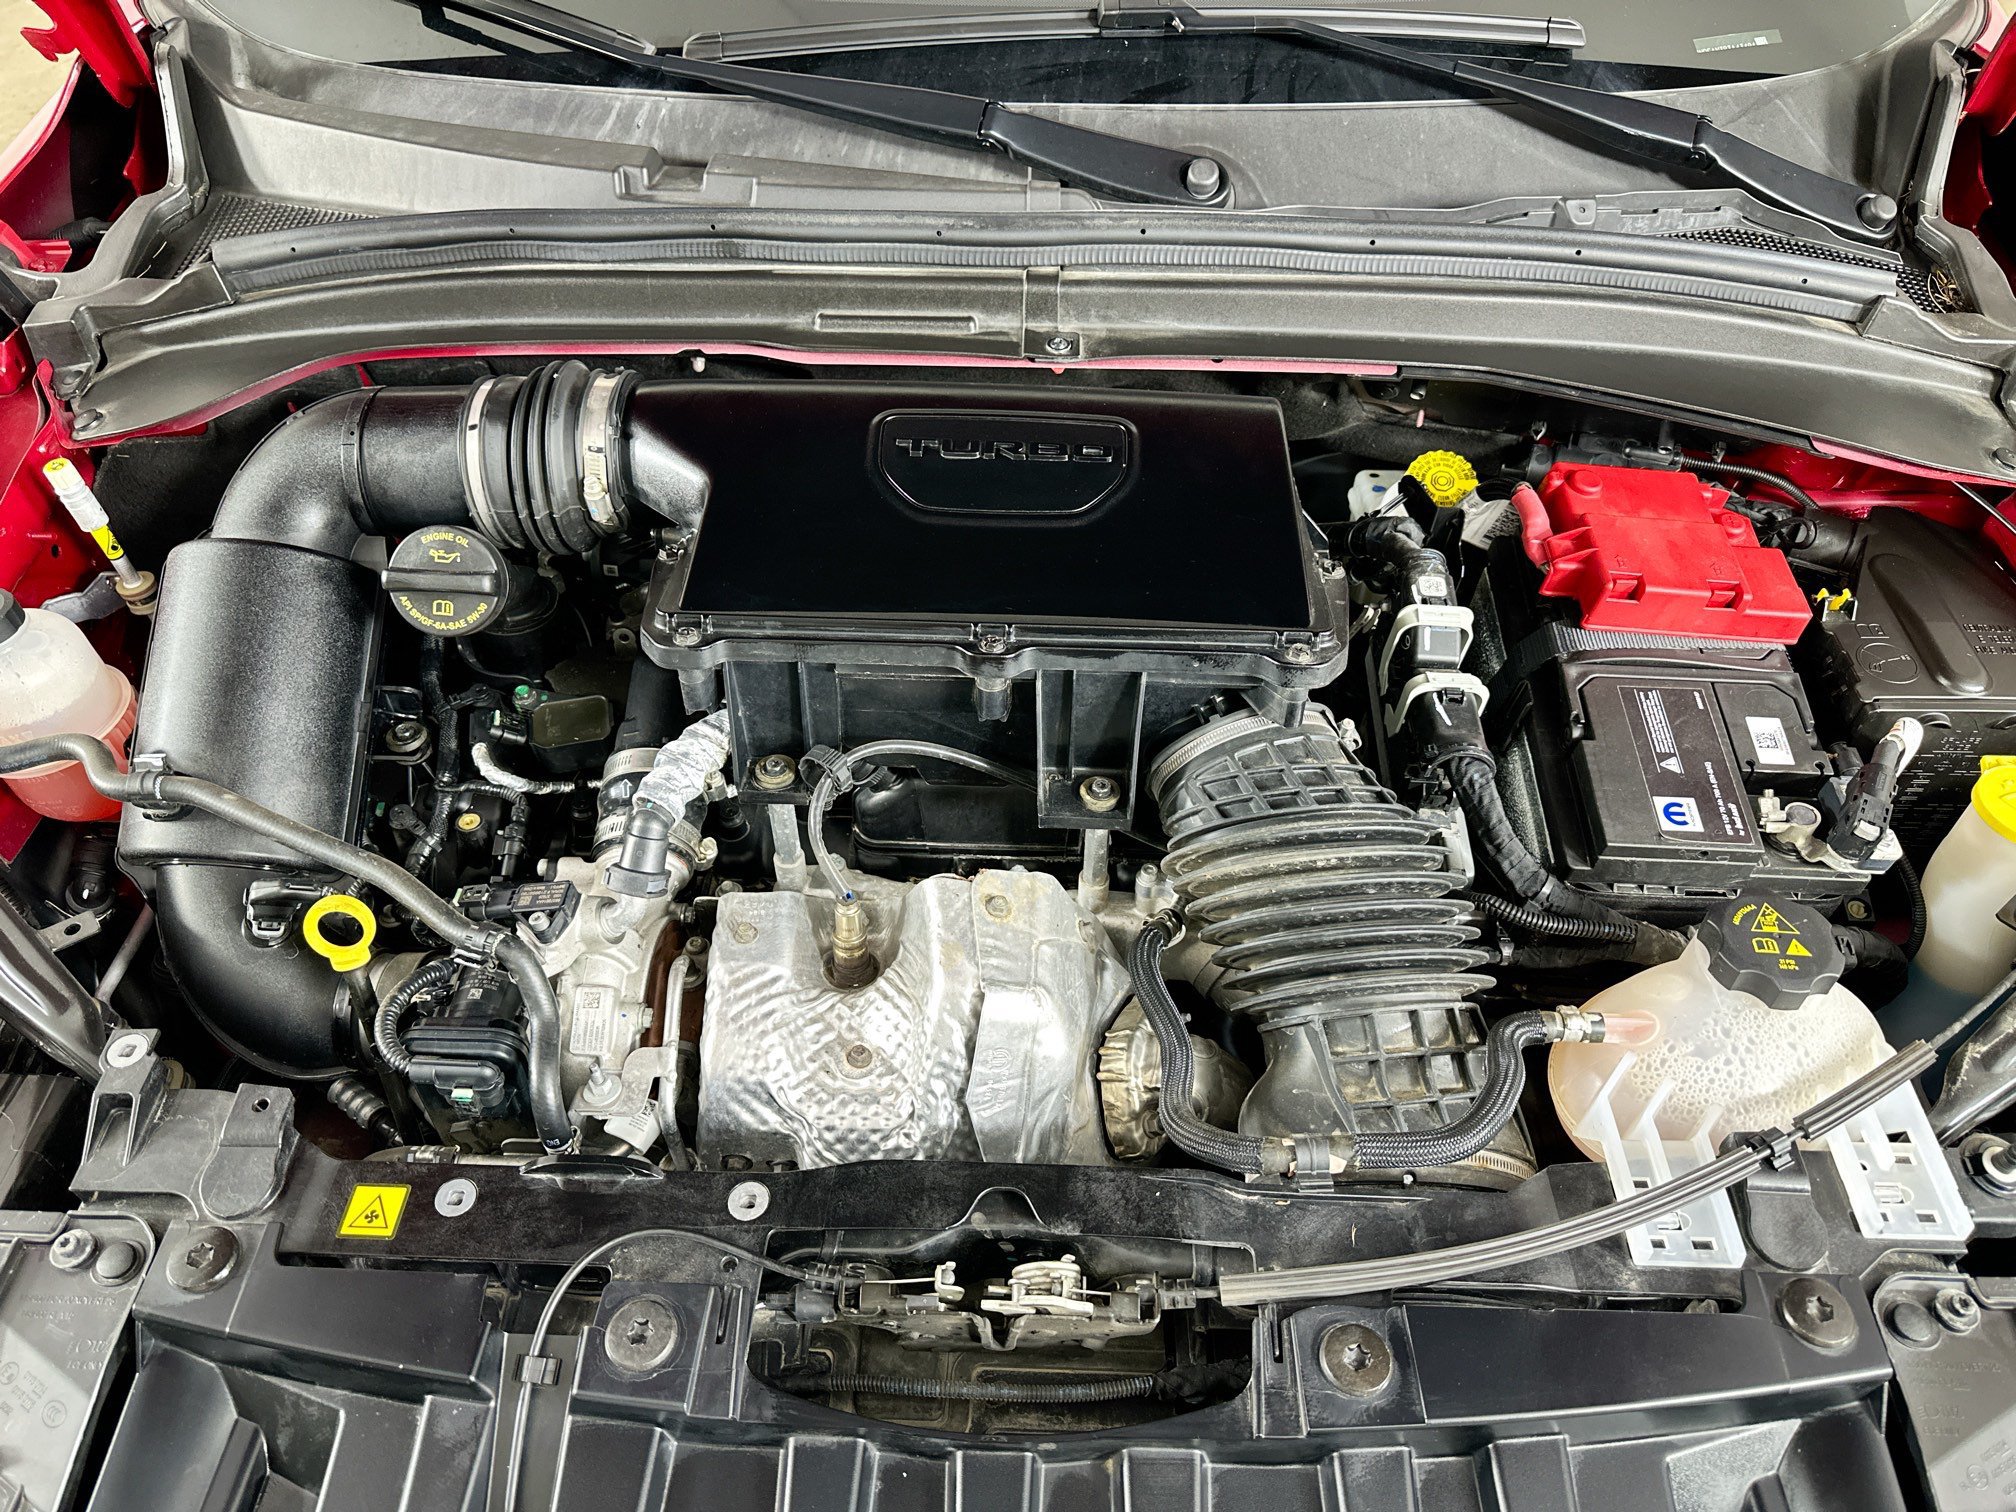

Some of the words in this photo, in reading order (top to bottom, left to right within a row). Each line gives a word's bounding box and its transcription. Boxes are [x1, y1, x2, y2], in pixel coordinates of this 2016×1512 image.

[895, 438, 1113, 463] TURBO
[420, 531, 455, 545] ENGINE
[455, 536, 469, 548] OIL
[399, 596, 414, 611] API
[409, 608, 468, 630] SP/GF-6A-SAE
[466, 602, 488, 624] 5W-30
